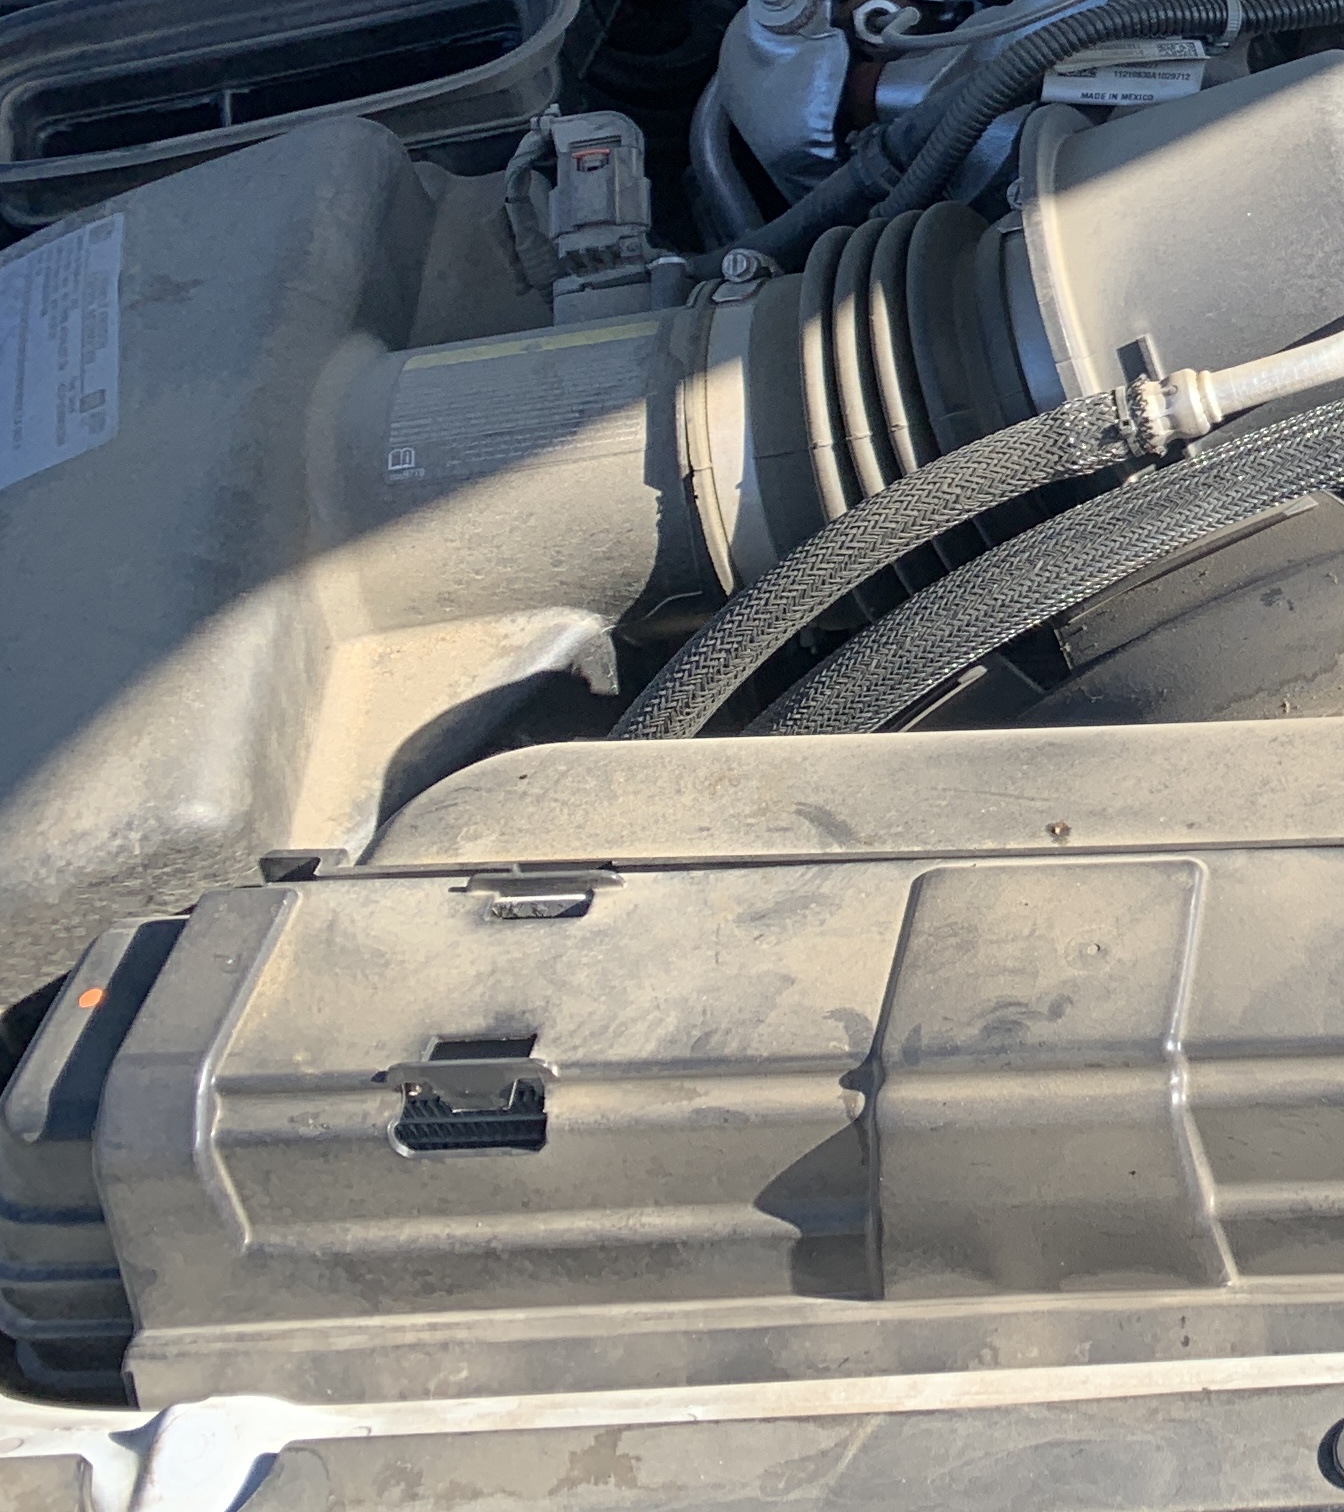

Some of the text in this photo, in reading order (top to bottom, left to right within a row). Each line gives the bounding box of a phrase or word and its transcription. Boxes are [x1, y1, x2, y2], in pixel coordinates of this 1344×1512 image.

[1081, 92, 1154, 101] MADE IN MEXICO
